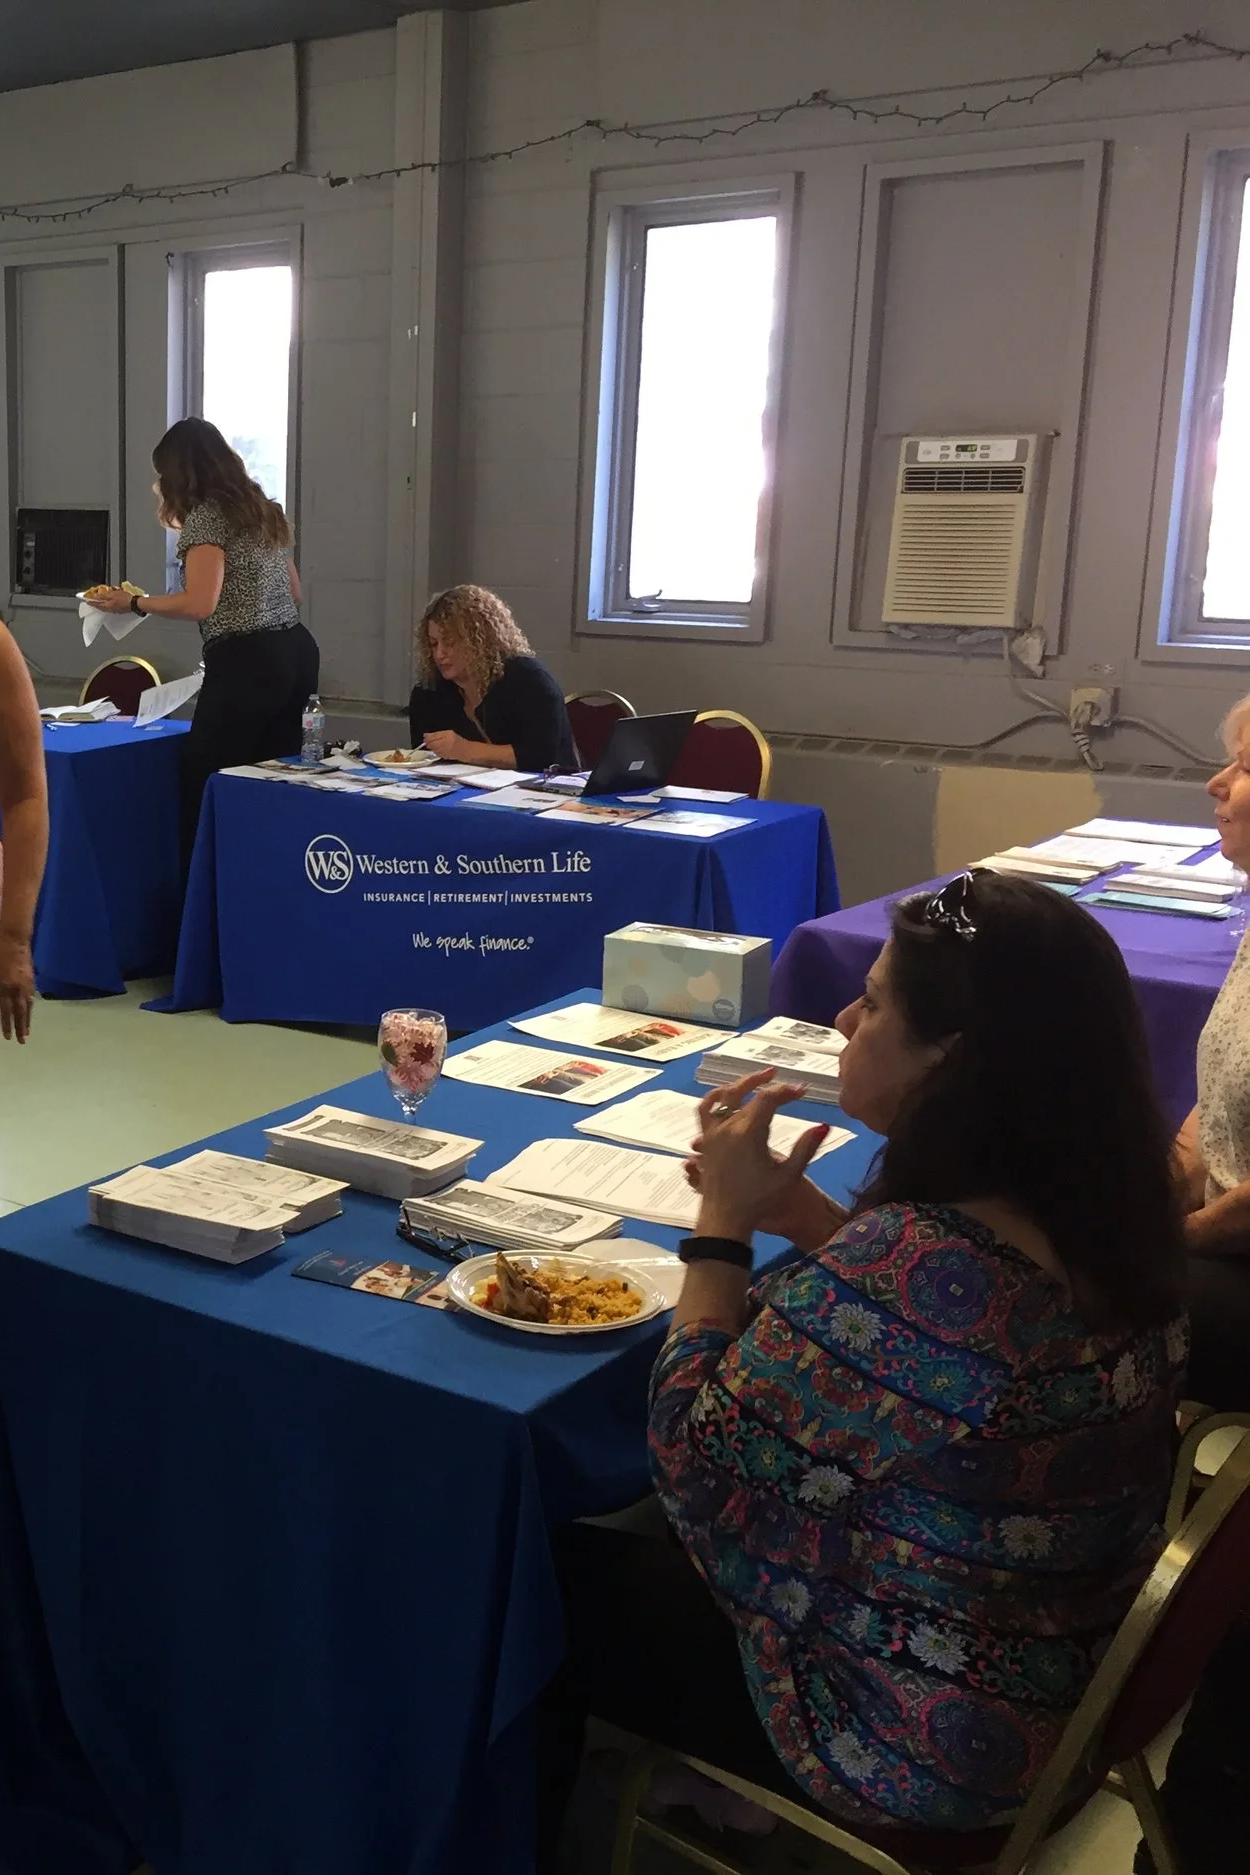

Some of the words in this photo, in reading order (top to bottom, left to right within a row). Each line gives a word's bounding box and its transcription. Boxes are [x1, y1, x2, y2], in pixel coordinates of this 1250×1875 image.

[356, 854, 430, 875] Western
[434, 854, 452, 875] &
[457, 854, 546, 875] Southern
[551, 850, 591, 873] Life
[363, 893, 425, 903] INSURANCE
[433, 893, 504, 903] RETIREMENT
[511, 892, 593, 903] INVESTMENTS
[413, 932, 432, 948] We
[436, 932, 475, 957] speak
